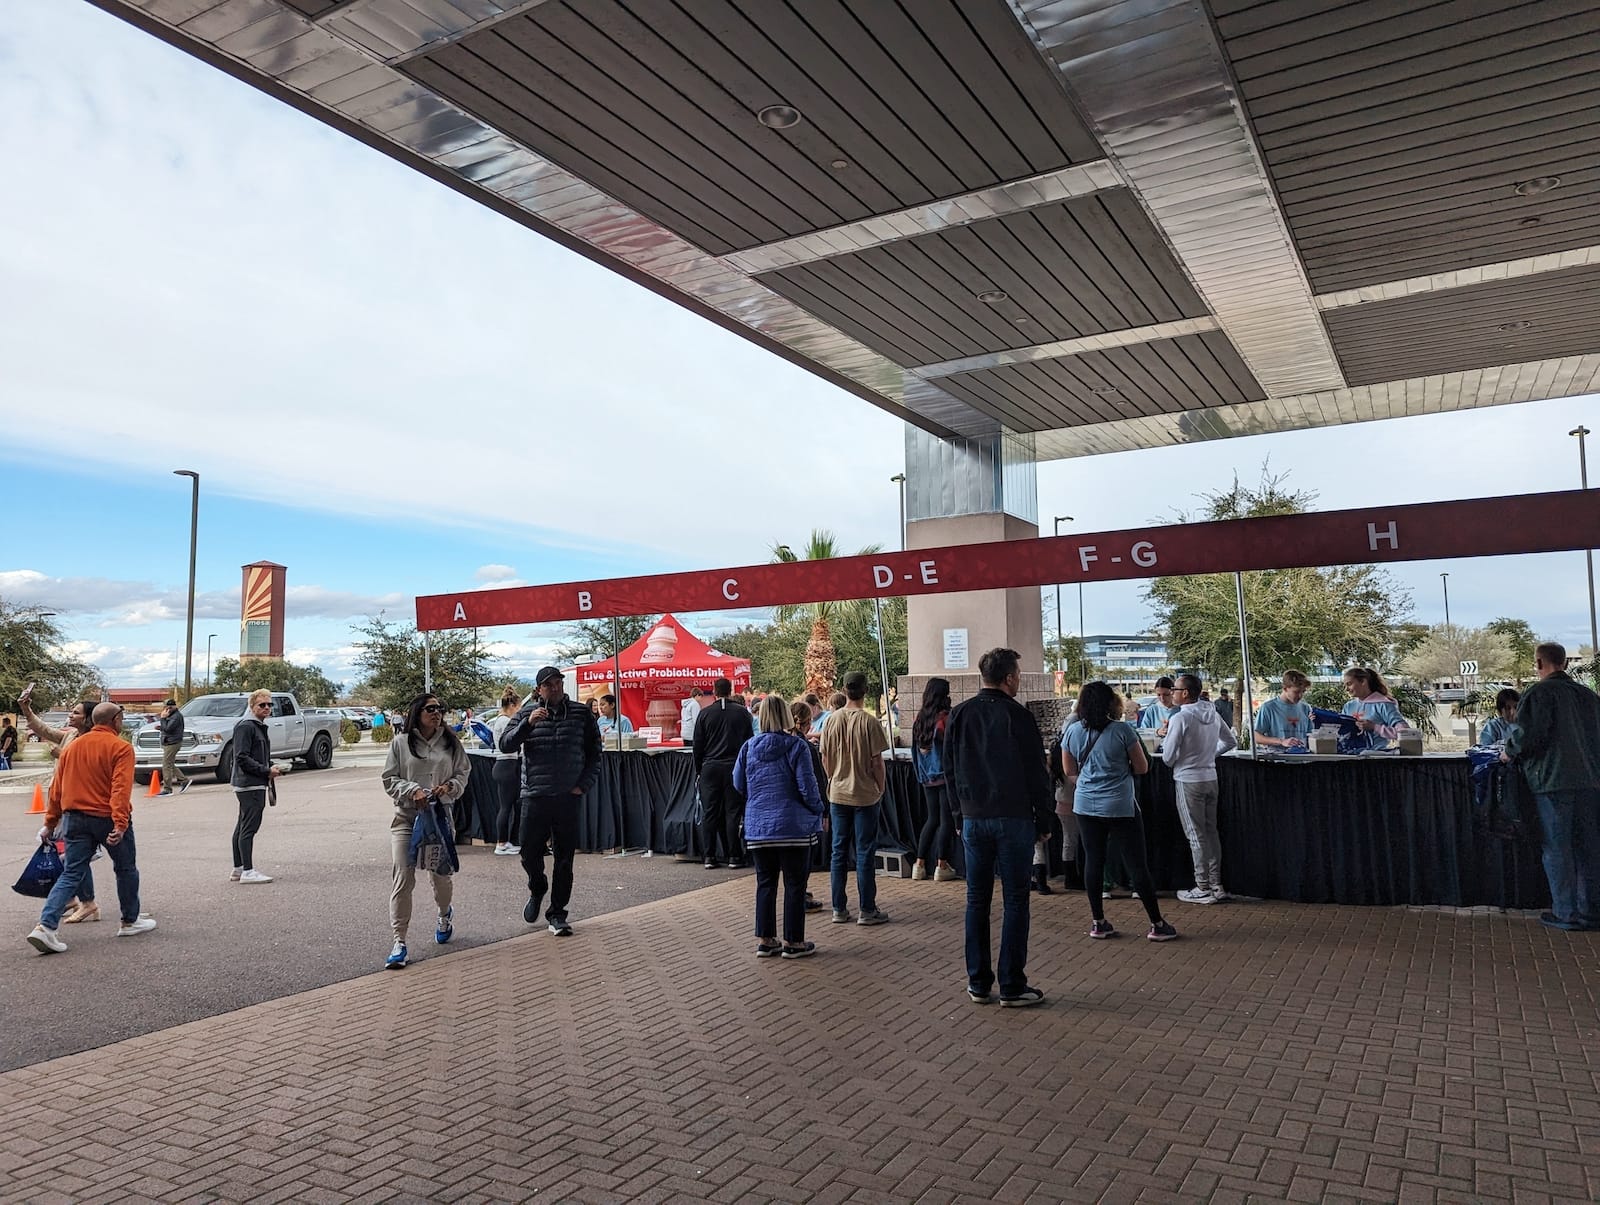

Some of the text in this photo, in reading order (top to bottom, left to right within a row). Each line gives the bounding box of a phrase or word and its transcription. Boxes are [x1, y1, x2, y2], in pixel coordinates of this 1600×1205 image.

[453, 602, 467, 621] A
[578, 591, 593, 611] B
[722, 578, 739, 601] C
[1078, 546, 1098, 571] F
[1131, 541, 1157, 567] G
[1367, 520, 1399, 551] H
[583, 671, 605, 681] Live
[606, 670, 615, 680] &
[649, 667, 695, 678] Probiotic
[696, 667, 724, 678] Drink
